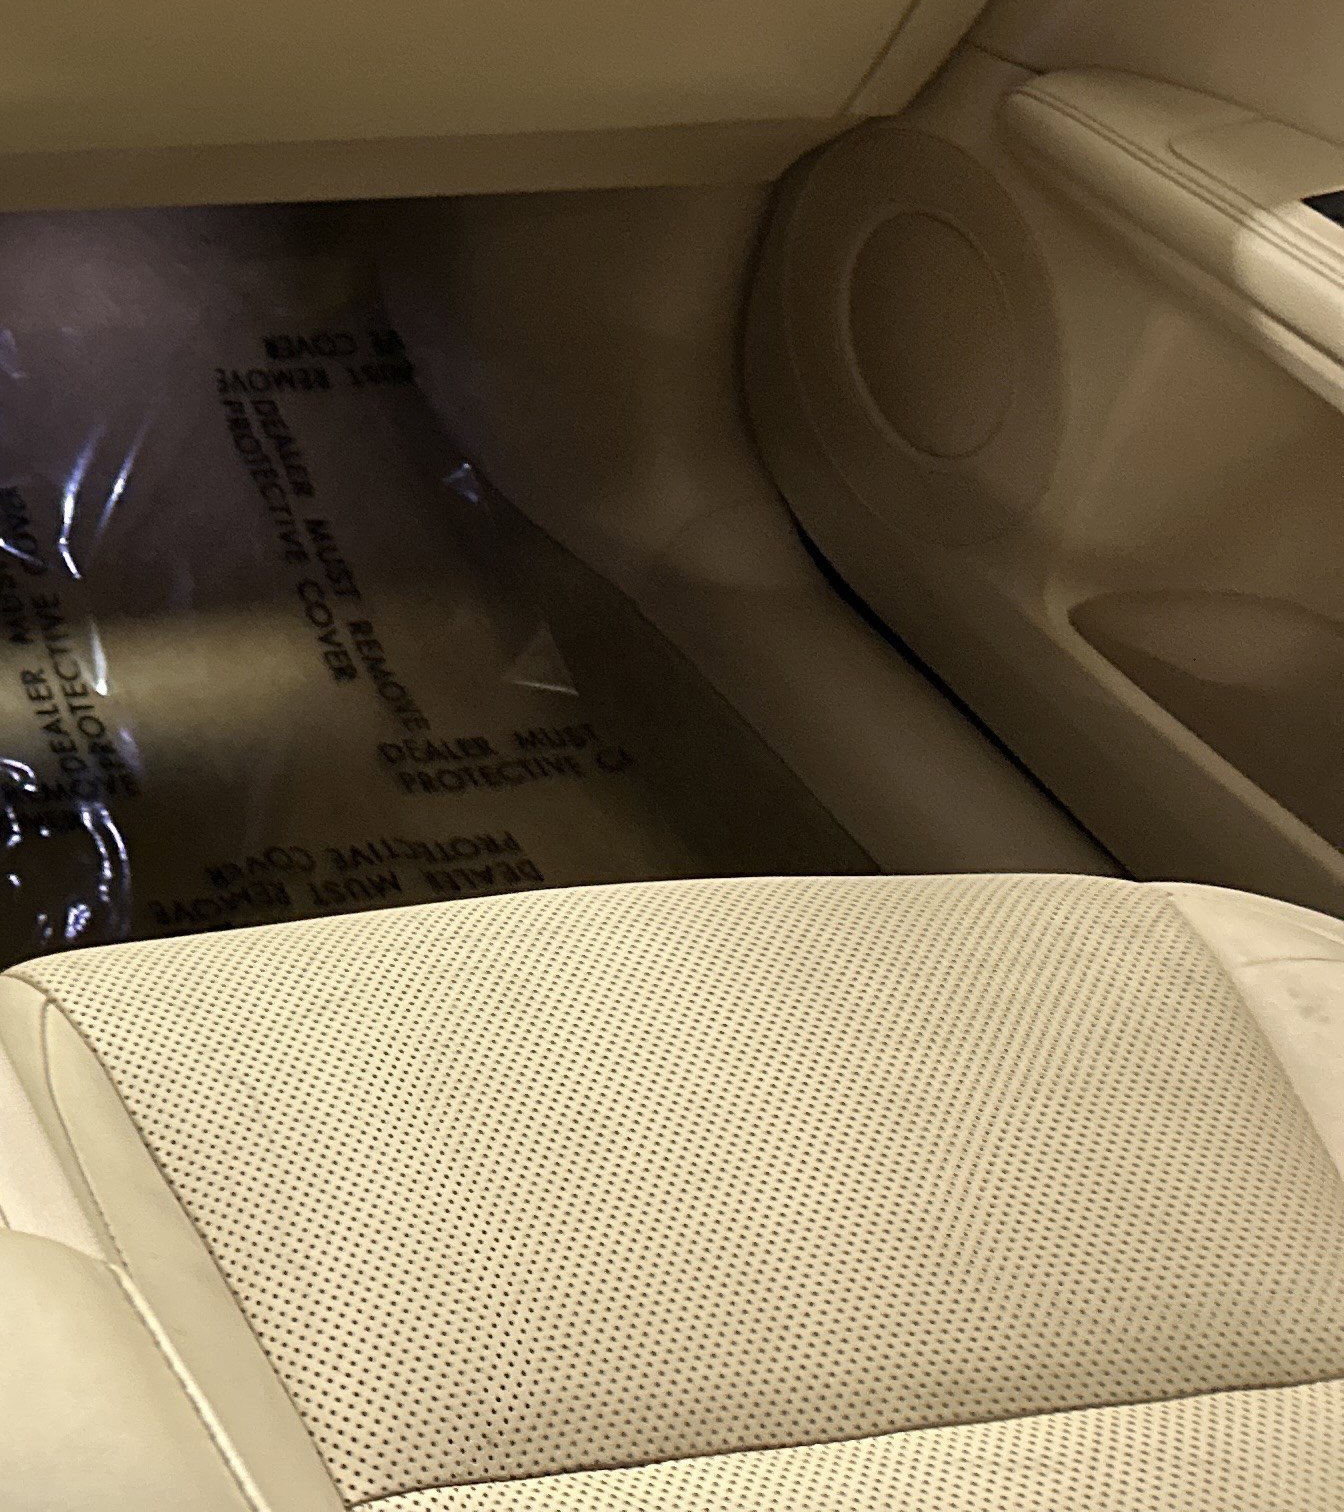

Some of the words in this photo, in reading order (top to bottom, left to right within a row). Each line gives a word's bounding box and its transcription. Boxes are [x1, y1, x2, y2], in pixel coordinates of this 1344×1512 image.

[296, 578, 358, 684] COVER
[348, 620, 431, 731] REMOVE
[20, 668, 88, 773] DEALER
[377, 734, 498, 767] DEALER
[513, 723, 601, 752] MUST
[399, 751, 587, 795] PROTECTIVE
[327, 830, 521, 874] PROTECTIVE
[312, 869, 403, 907] MUST
